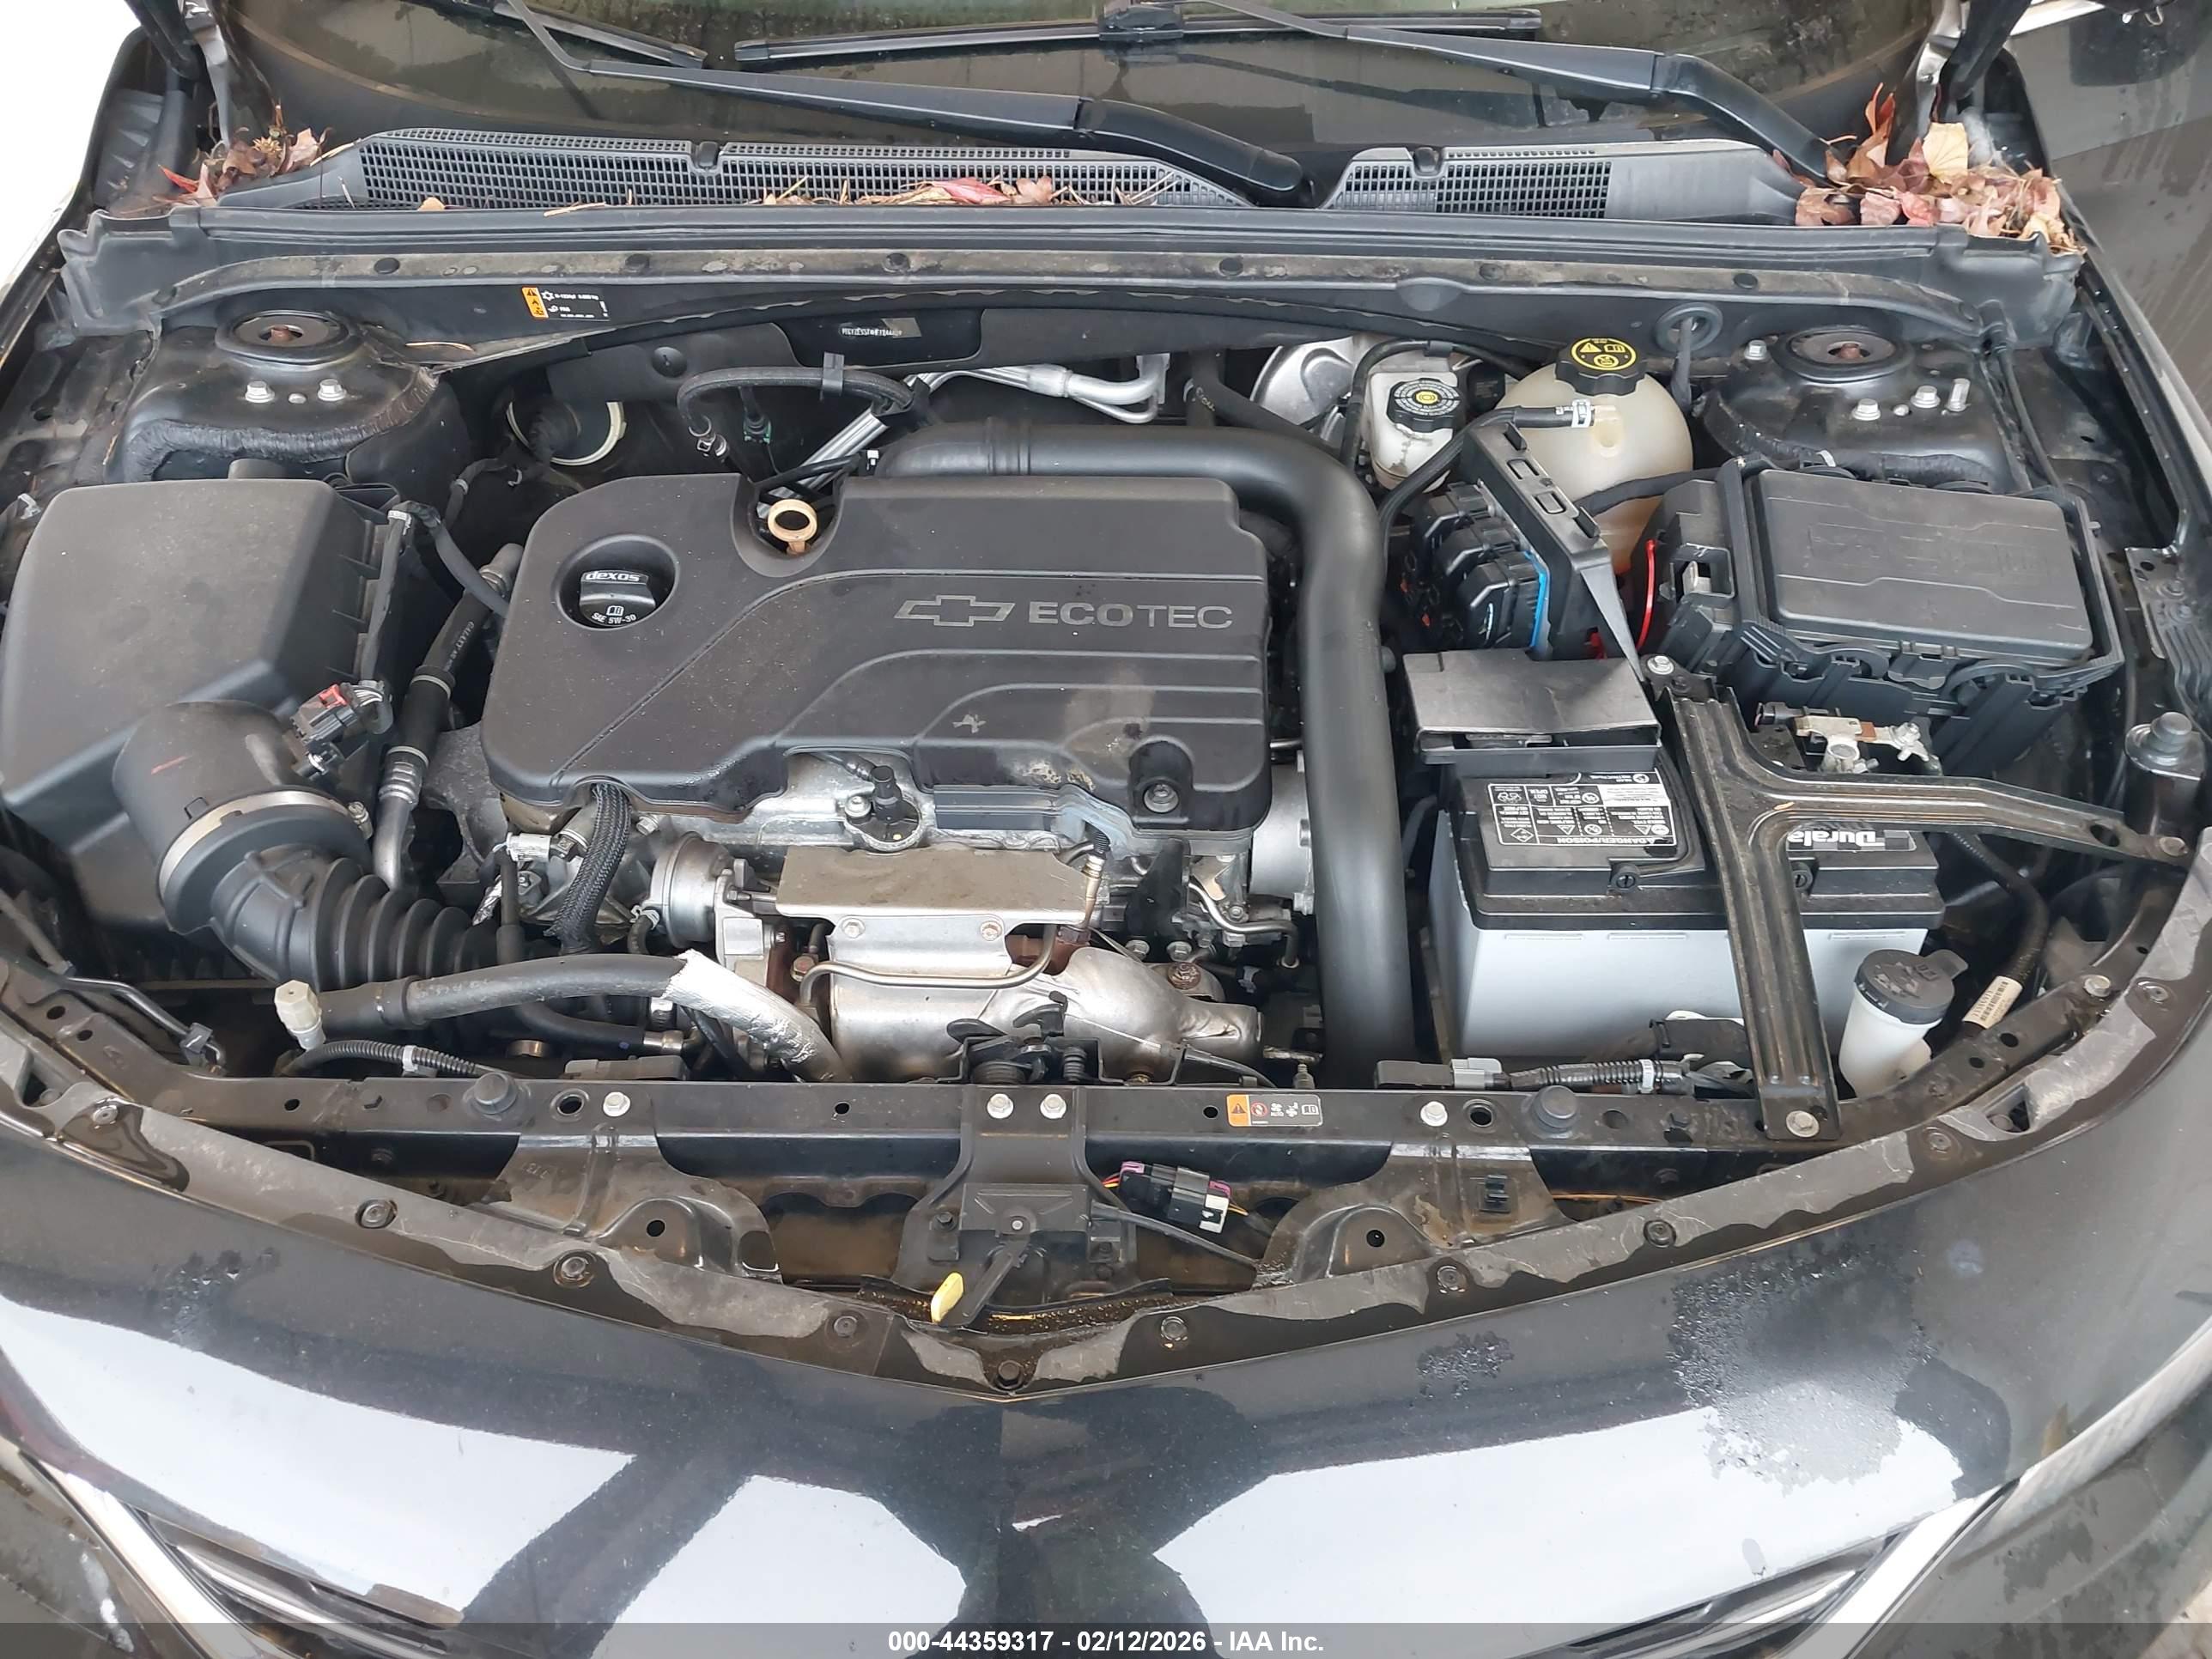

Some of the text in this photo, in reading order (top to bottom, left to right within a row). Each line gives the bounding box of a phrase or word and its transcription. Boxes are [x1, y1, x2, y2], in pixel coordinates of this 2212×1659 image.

[586, 571, 640, 582] dexos
[592, 612, 637, 624] SAE 5W-30
[1029, 601, 1233, 629] ECOTEC
